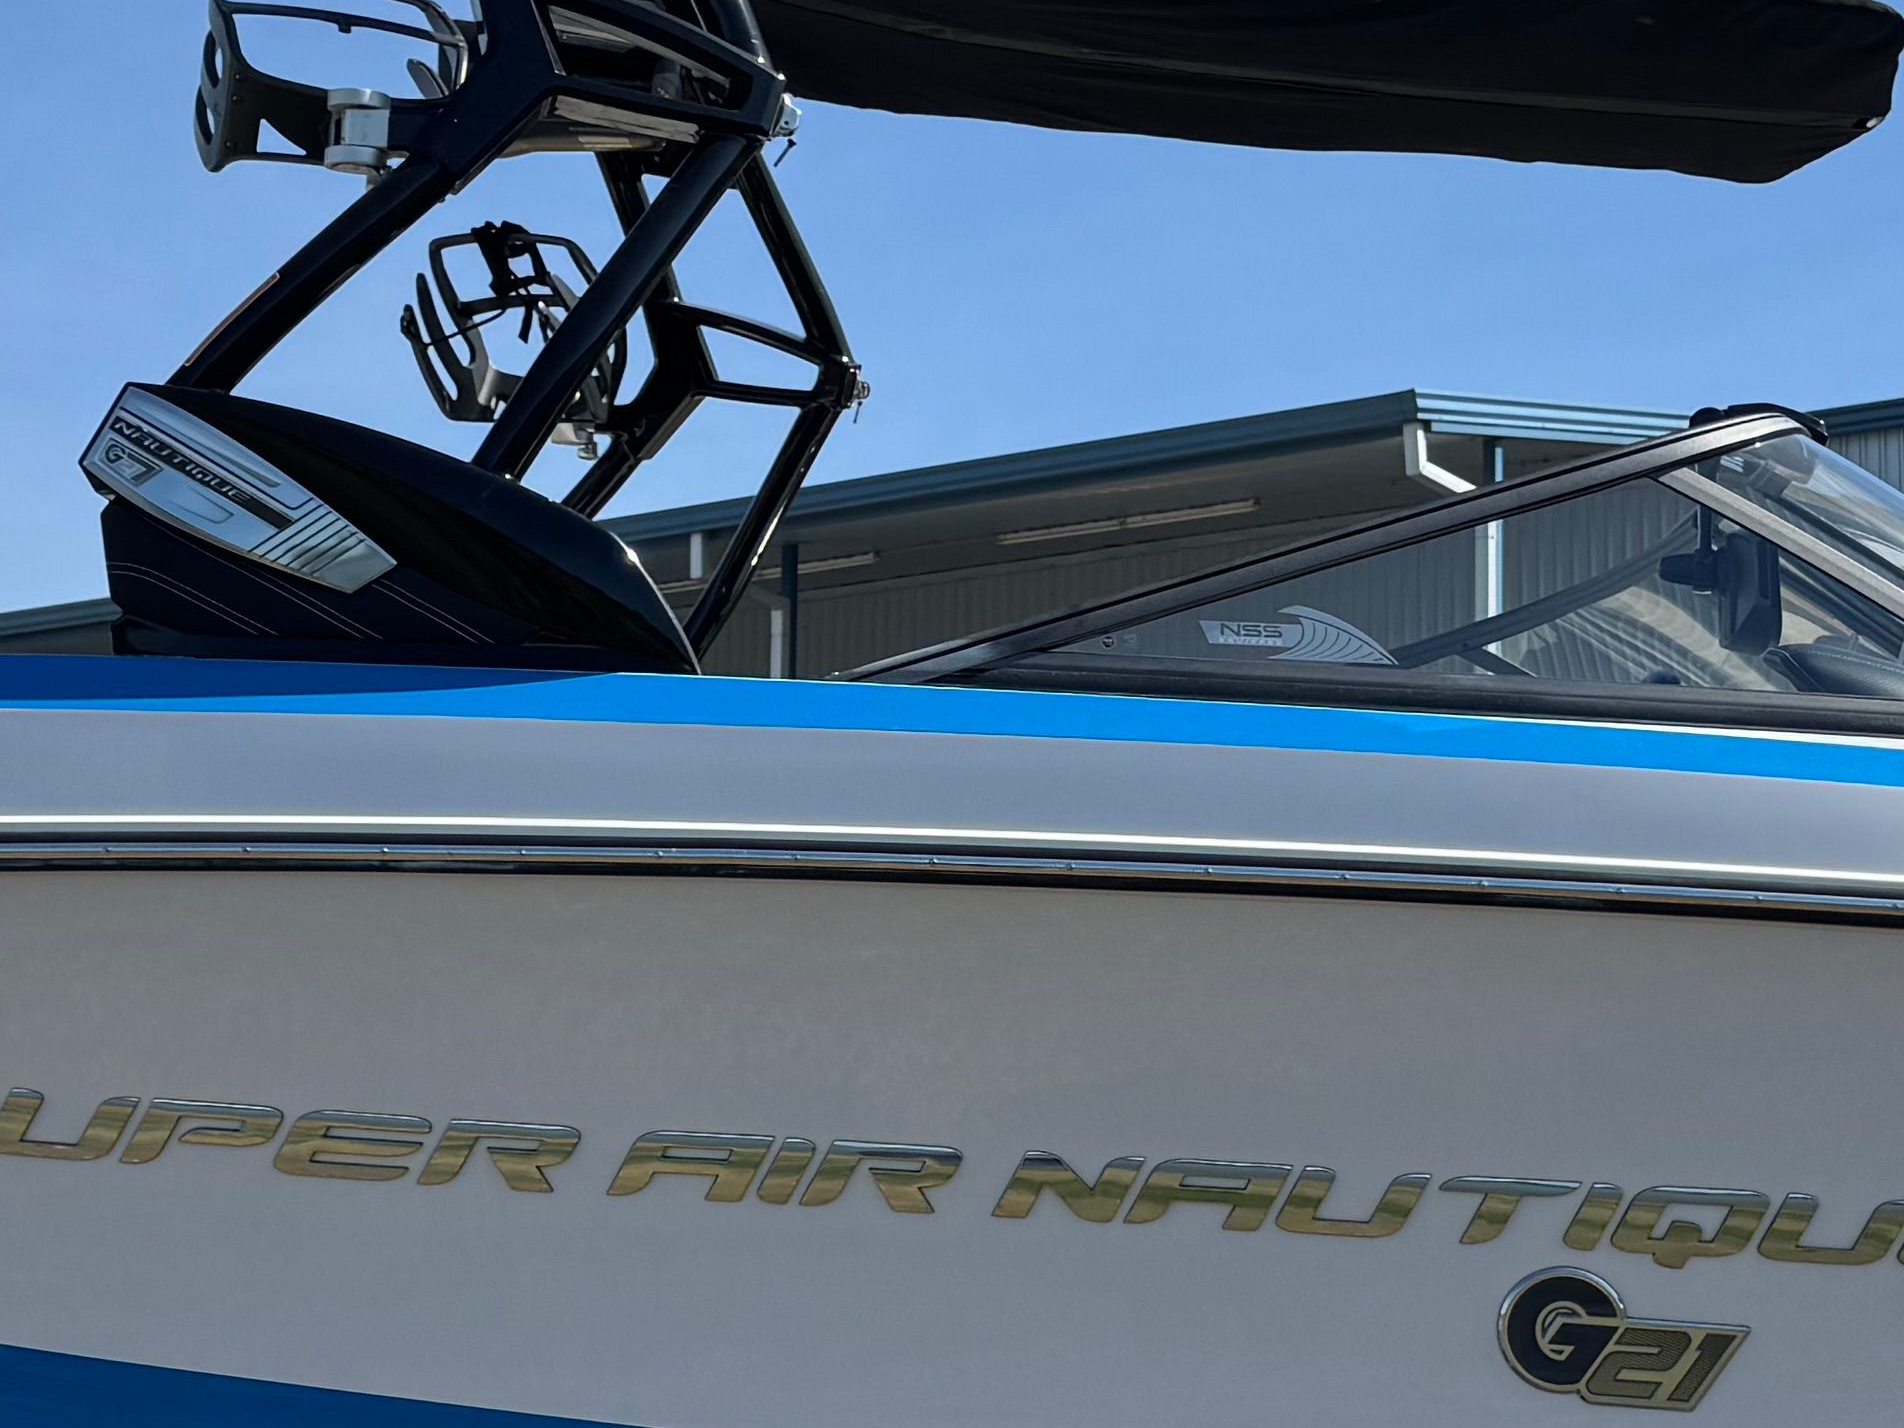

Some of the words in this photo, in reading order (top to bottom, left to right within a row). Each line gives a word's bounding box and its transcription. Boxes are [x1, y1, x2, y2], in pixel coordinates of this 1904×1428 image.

[112, 421, 251, 502] NAUTIQUE
[1220, 623, 1282, 638] NSS
[606, 1130, 964, 1214] AIR
[1498, 1267, 1751, 1411] G21
